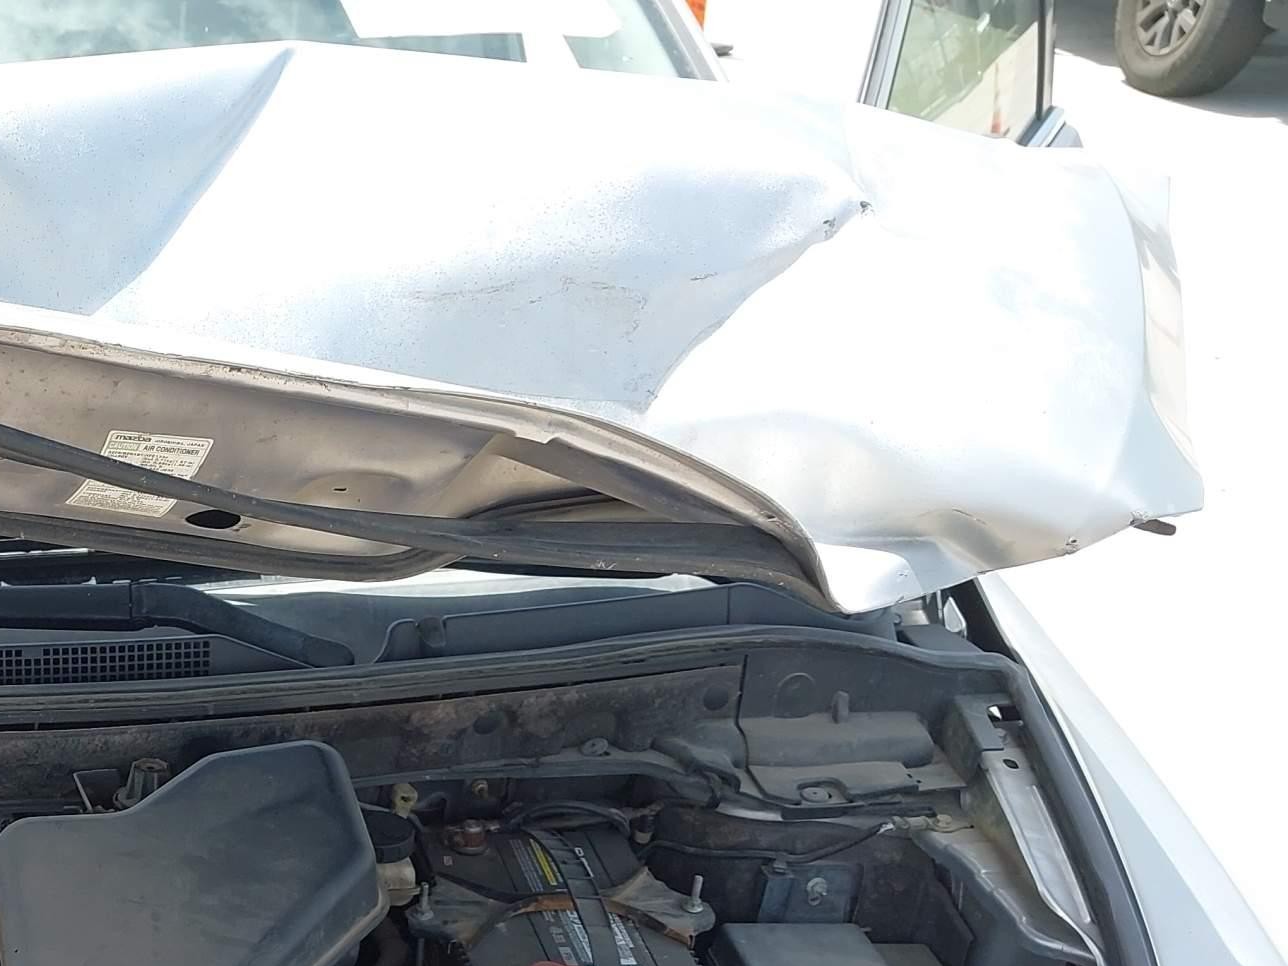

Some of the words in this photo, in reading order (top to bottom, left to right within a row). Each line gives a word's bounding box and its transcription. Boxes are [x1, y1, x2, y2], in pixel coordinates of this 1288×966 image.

[115, 434, 152, 443] mazda
[143, 445, 155, 453] AIR
[155, 446, 200, 456] CONDITIONER
